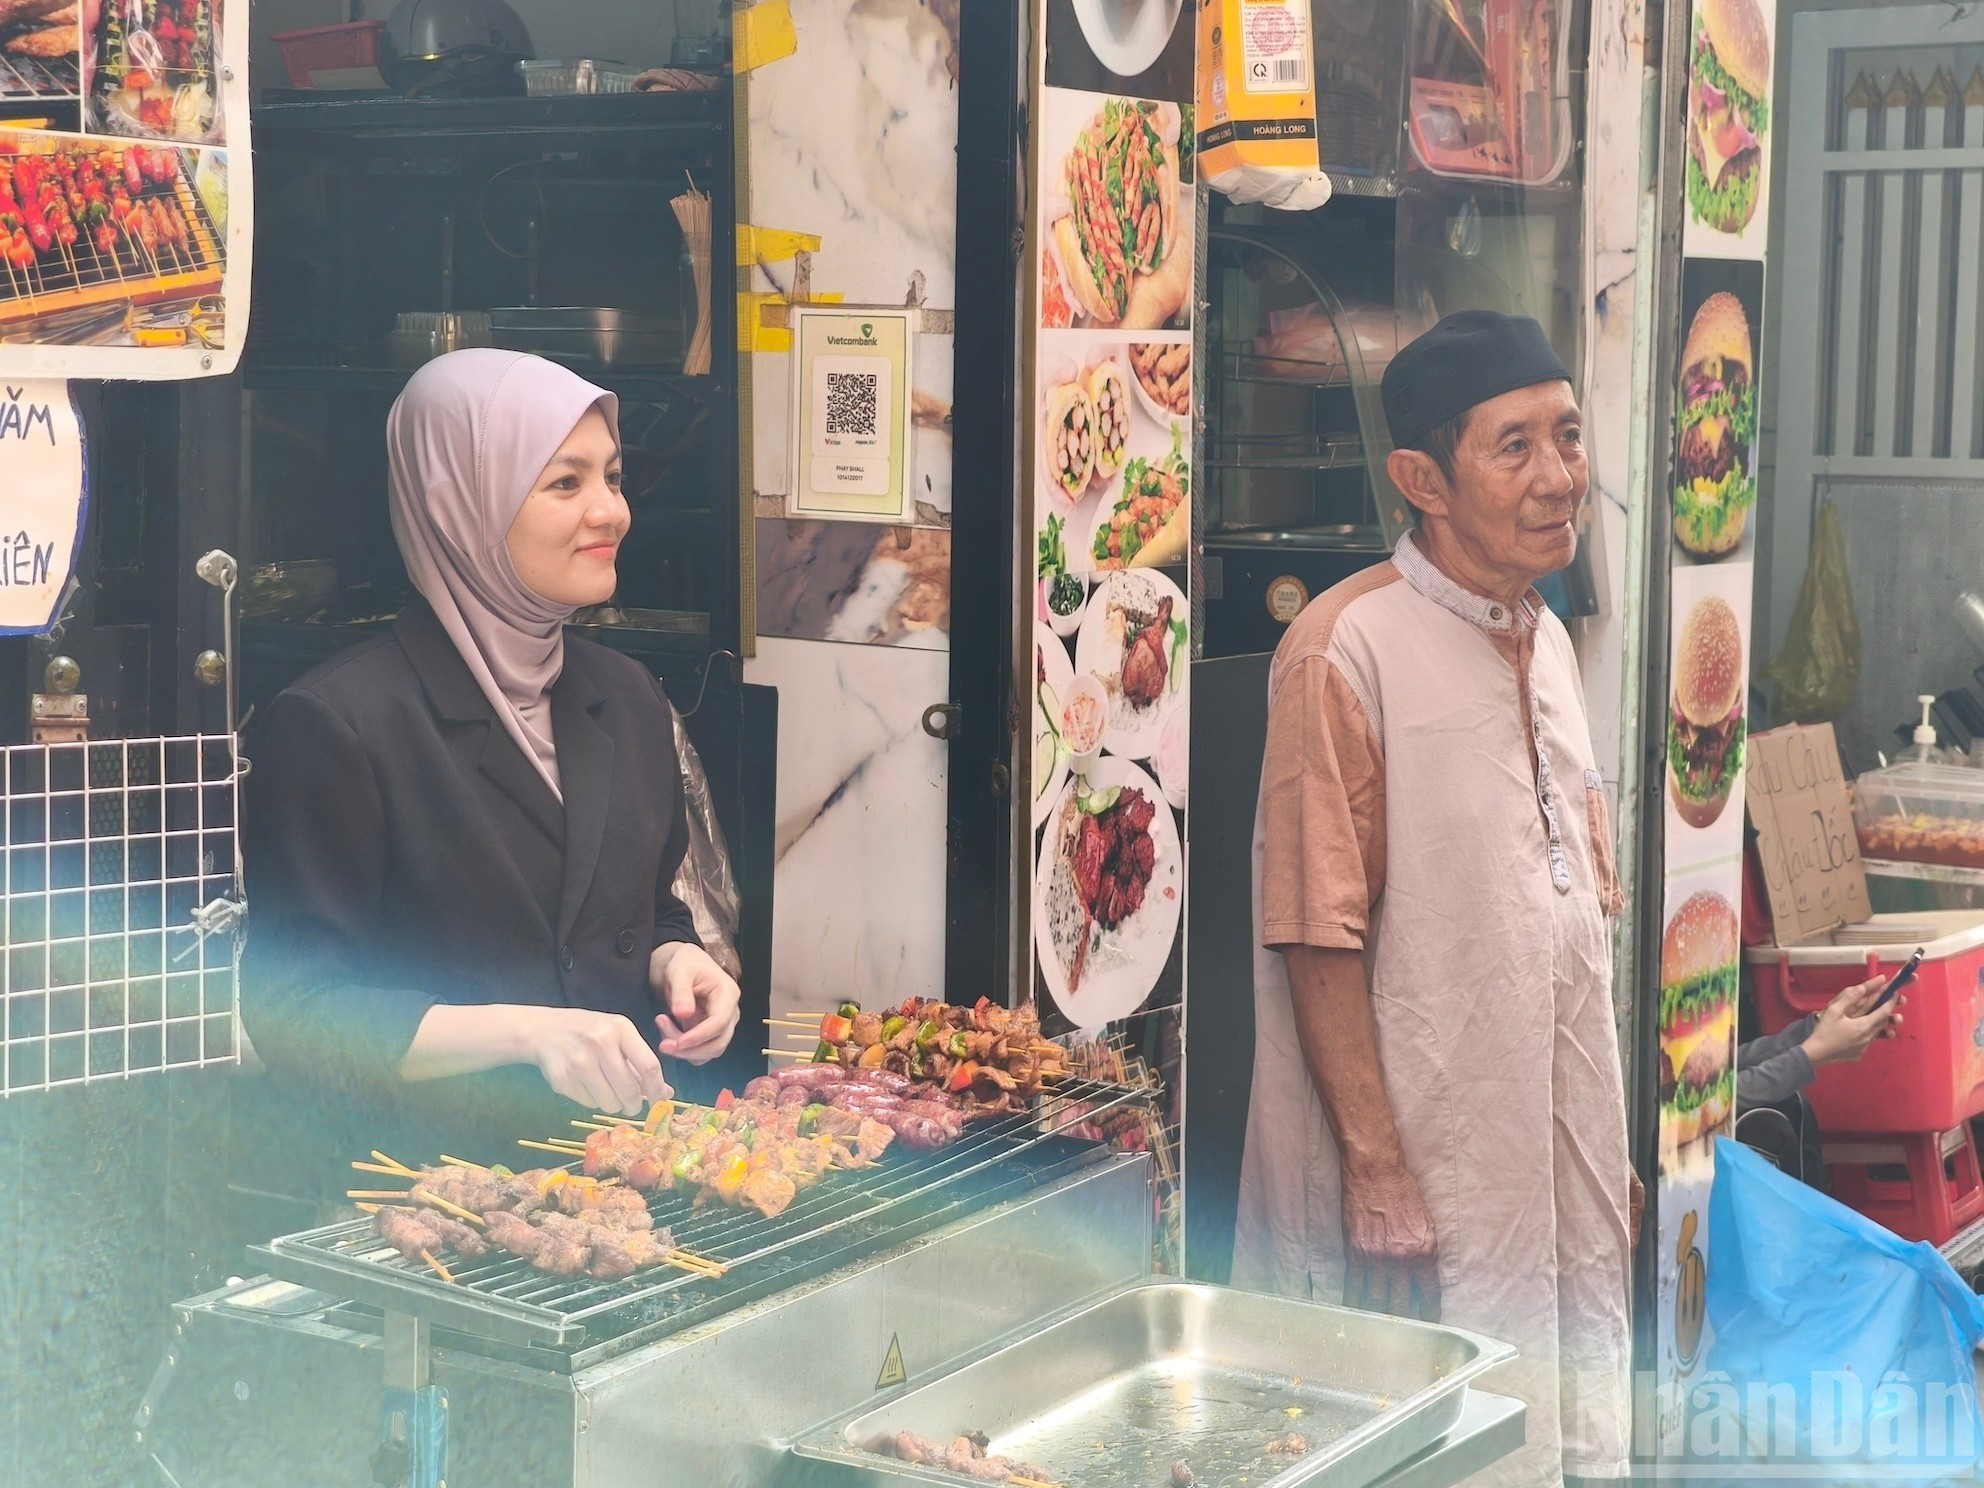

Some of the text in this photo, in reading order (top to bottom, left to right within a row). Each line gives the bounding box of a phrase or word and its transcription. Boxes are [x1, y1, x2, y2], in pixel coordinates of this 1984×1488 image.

[1253, 124, 1306, 135] HOÀNG LONG
[827, 336, 878, 346] Vietcombank
